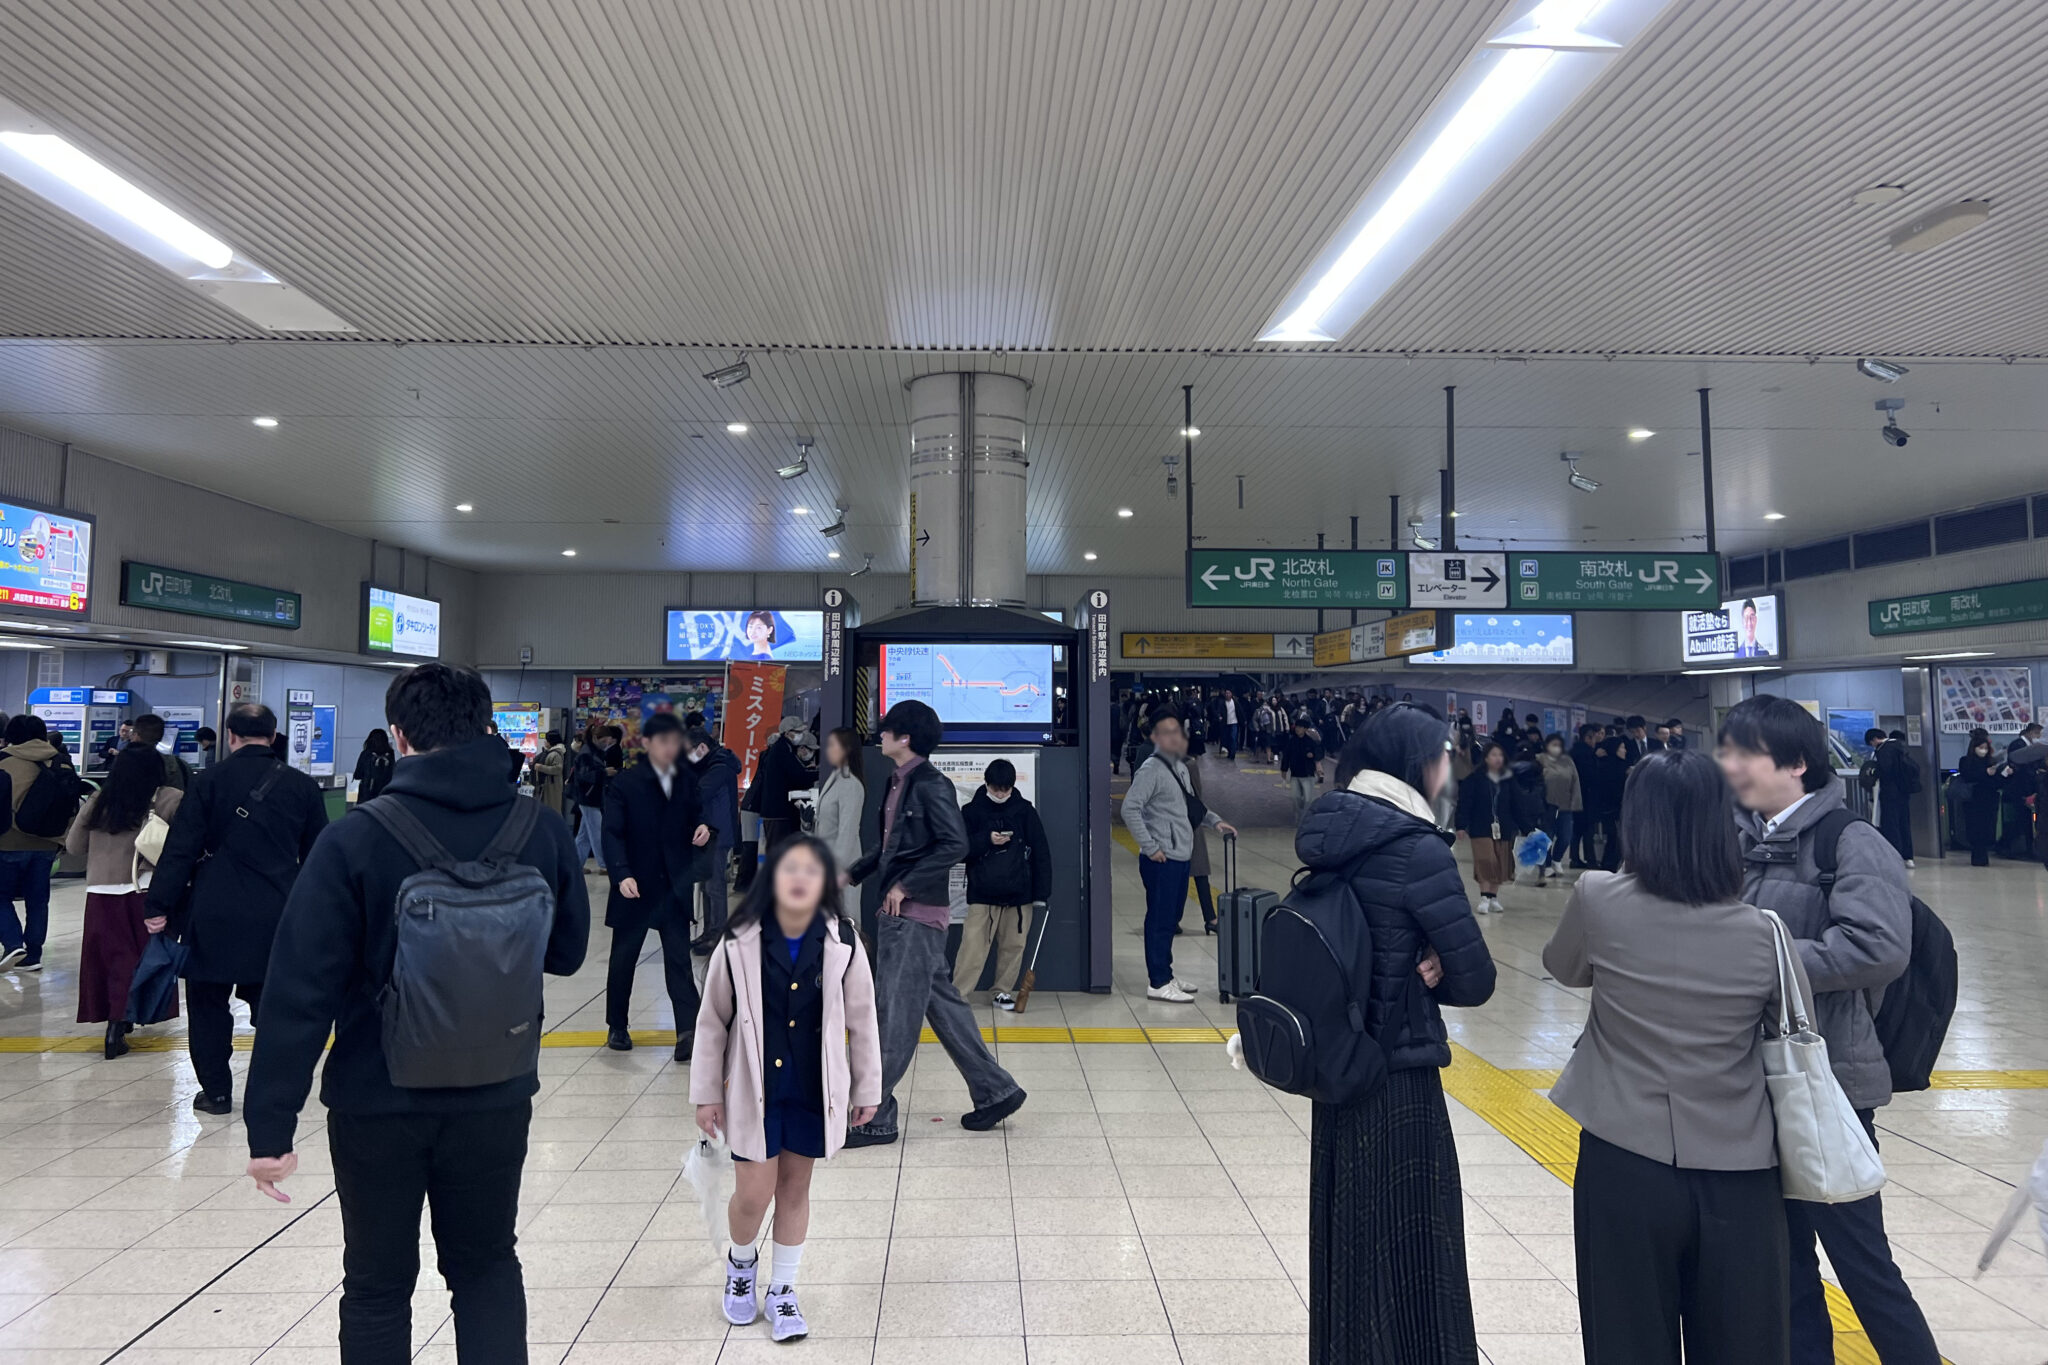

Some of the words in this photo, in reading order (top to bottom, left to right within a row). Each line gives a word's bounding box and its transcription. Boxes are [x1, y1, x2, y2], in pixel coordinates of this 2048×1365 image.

[1234, 557, 1276, 580] JR
[1282, 558, 1335, 576] 北改札
[1380, 564, 1392, 573] JK
[1523, 564, 1535, 573] JK
[1579, 560, 1633, 577] 南改札
[1638, 560, 1679, 583] JR
[142, 572, 164, 596] JR
[165, 576, 192, 595] 田町駅
[1282, 579, 1311, 588] North
[1313, 579, 1338, 588] Gate
[1380, 586, 1392, 595] JY
[1417, 584, 1467, 592] エレベーター
[1523, 586, 1535, 595] JY
[1576, 580, 1606, 590] South
[1608, 580, 1633, 590] Gate
[1880, 603, 1900, 623] JR
[1902, 600, 1931, 616] 田町駅
[1950, 593, 1982, 611] 南改札
[1688, 612, 1728, 632] 就活塾なら
[830, 612, 841, 676] 田町駅周辺案内
[887, 647, 929, 656] 中央線快速
[1097, 613, 1107, 677] 田町駅周辺案内
[1689, 633, 1736, 654] Abuild就活
